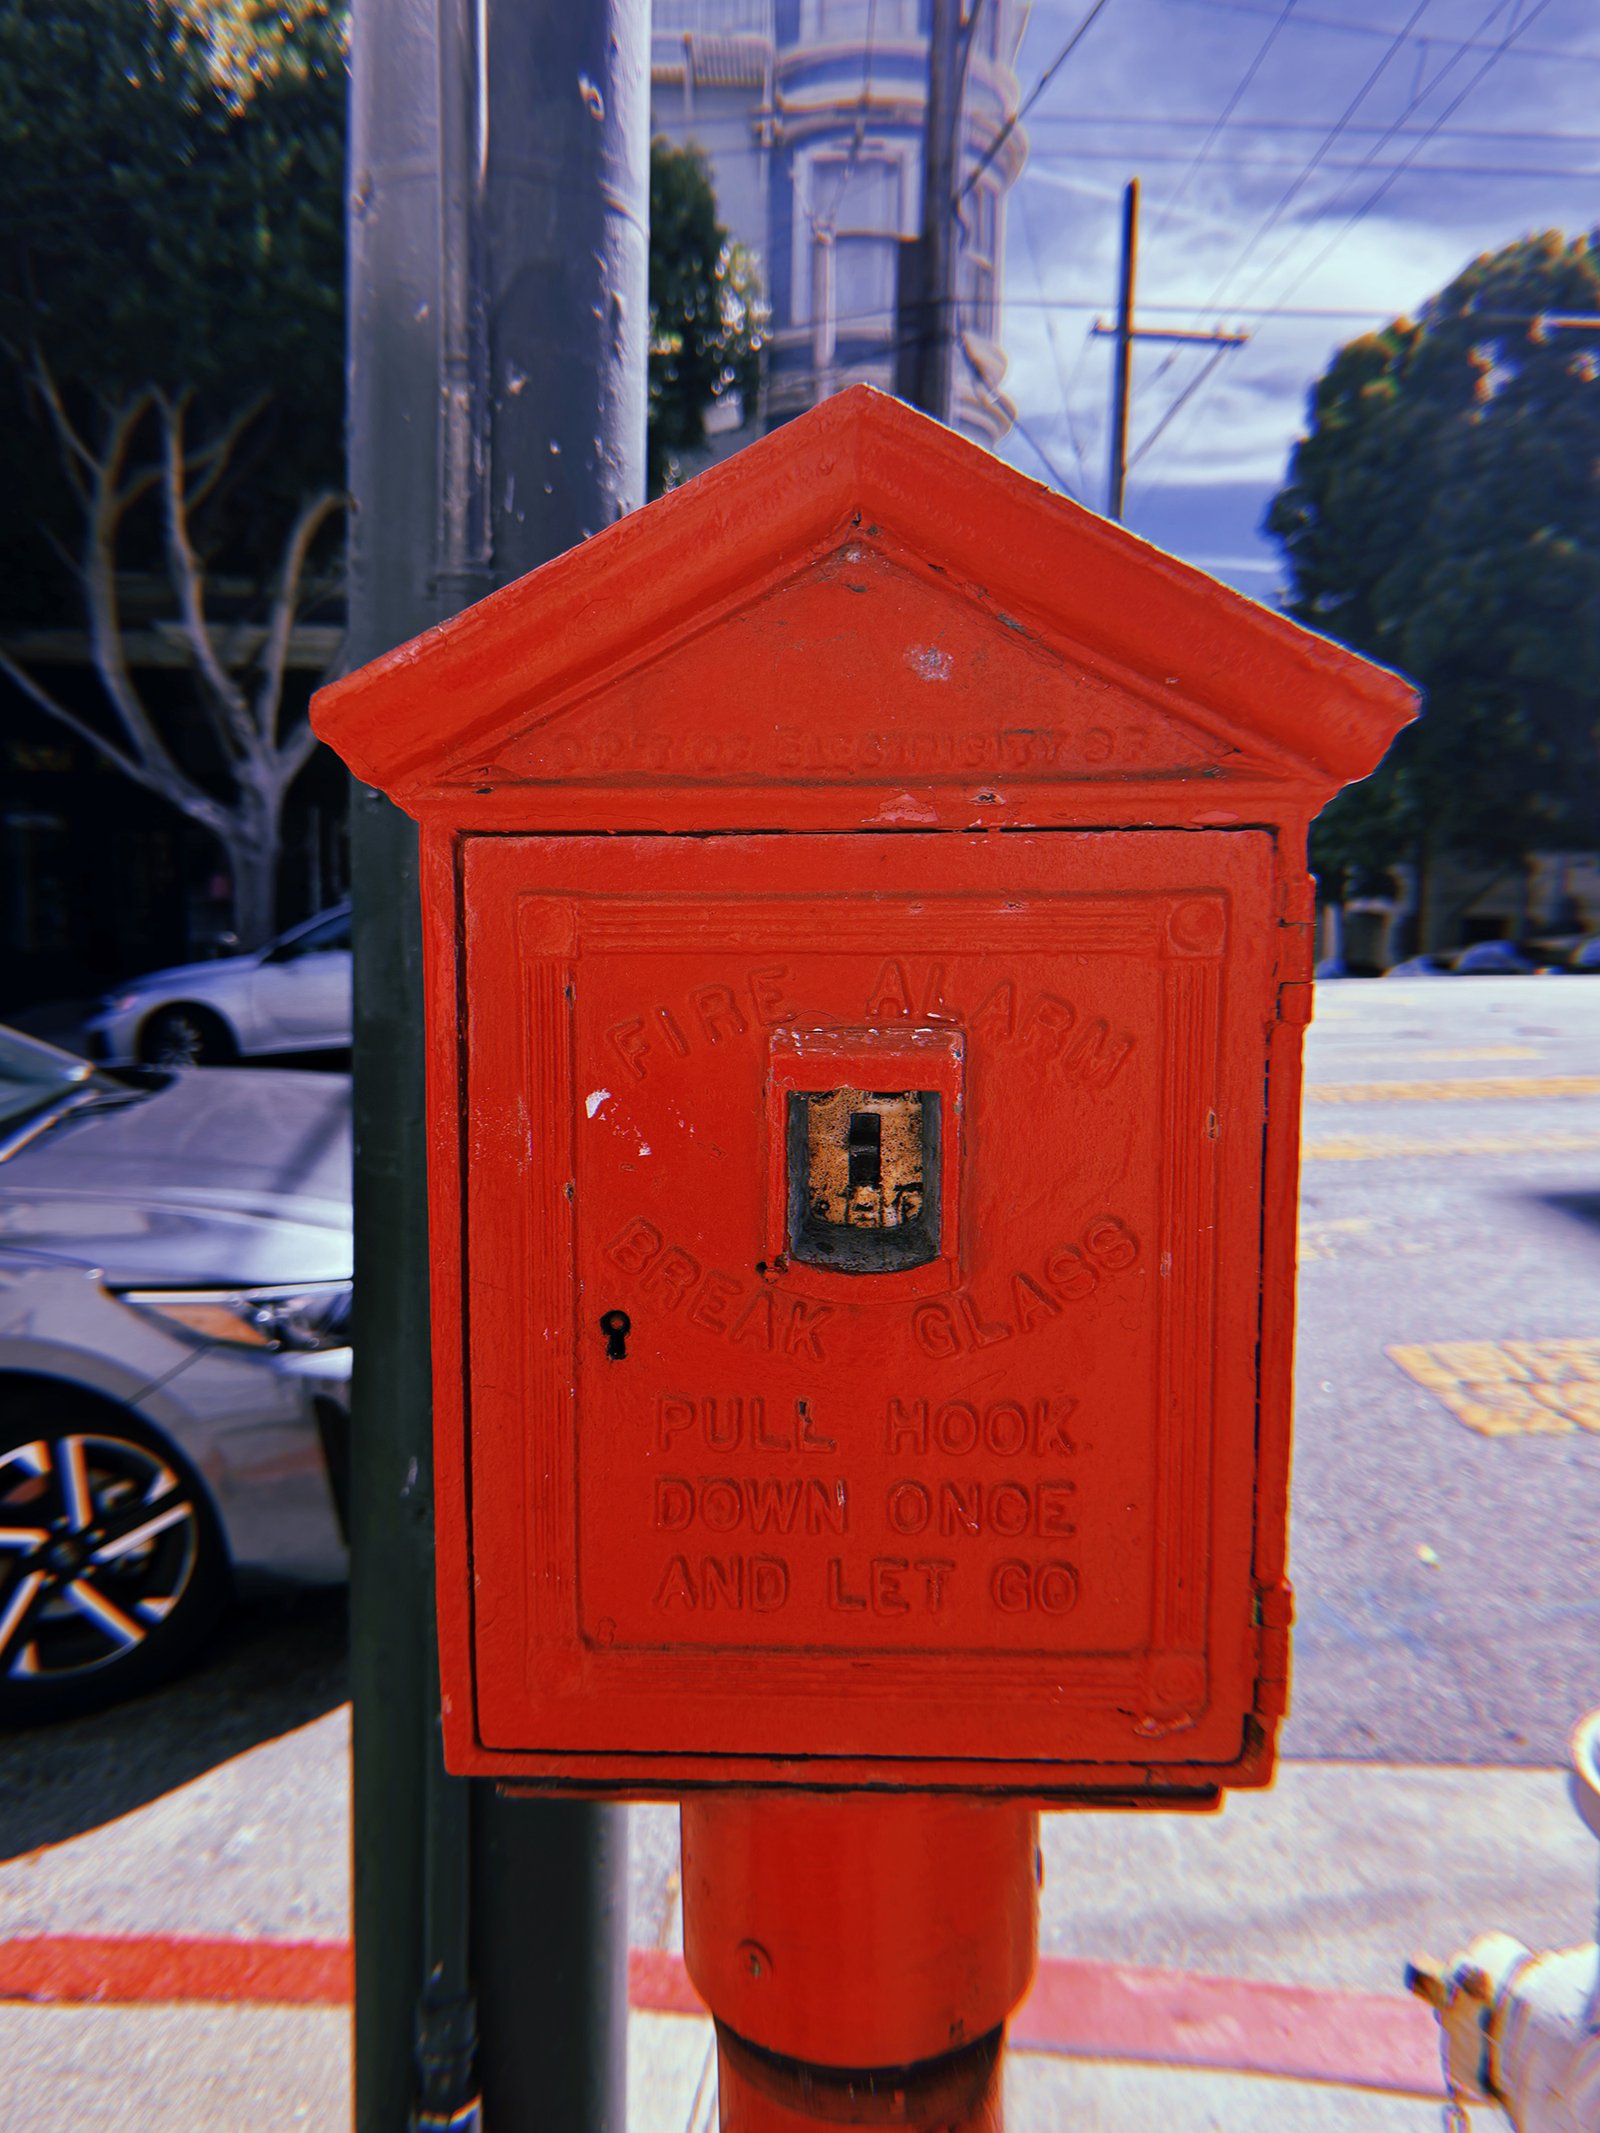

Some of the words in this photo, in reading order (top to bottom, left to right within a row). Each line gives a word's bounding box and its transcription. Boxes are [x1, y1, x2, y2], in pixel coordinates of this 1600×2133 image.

[606, 962, 797, 1080] FIRE
[865, 960, 1136, 1088] ALARM
[605, 1215, 837, 1363] BREAK
[910, 1213, 1140, 1359] GLASS
[655, 1396, 838, 1453] PULL
[886, 1397, 1080, 1456] HOOK
[655, 1474, 848, 1534] DOWN
[886, 1478, 1078, 1538] ONCE
[655, 1554, 791, 1613] AND
[827, 1556, 957, 1616] LET
[989, 1557, 1080, 1617] GO
